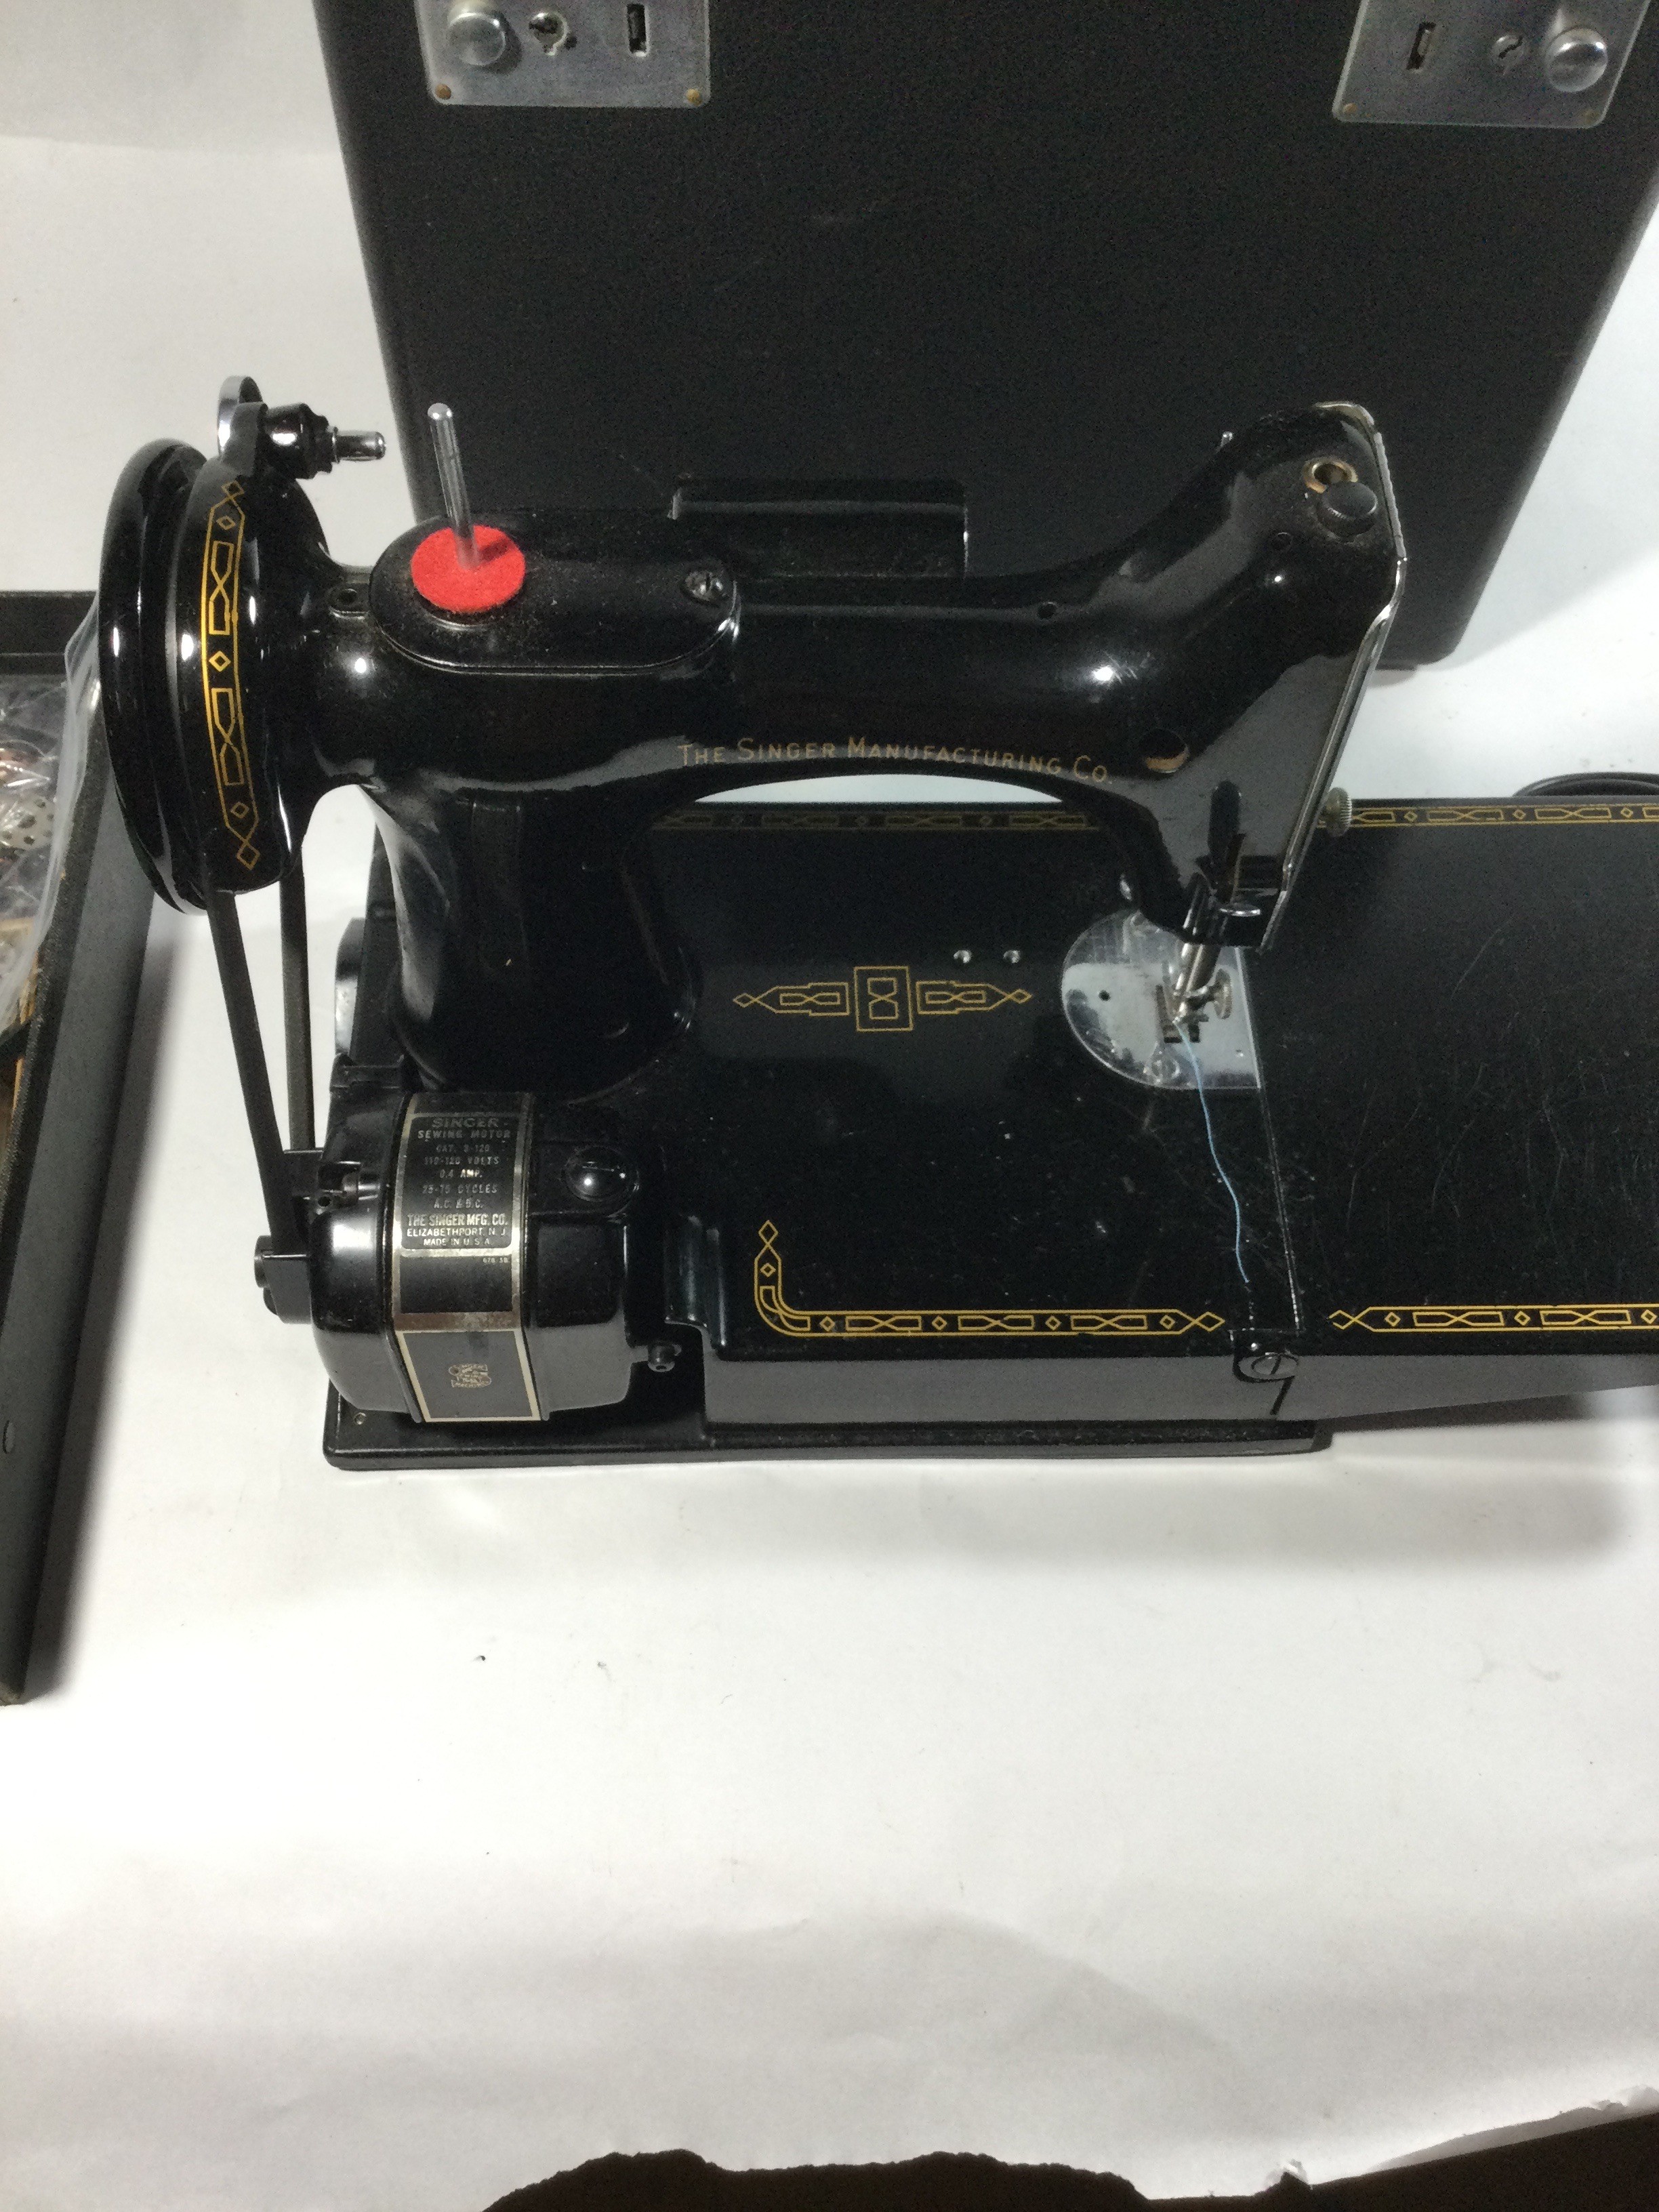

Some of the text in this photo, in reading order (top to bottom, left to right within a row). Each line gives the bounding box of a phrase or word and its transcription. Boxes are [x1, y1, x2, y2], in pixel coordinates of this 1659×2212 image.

[678, 743, 726, 766] THE
[737, 737, 836, 761] SINGER
[847, 735, 1062, 775] MANUFACTURING
[432, 1118, 499, 1128] SINGER
[417, 1130, 510, 1139] SEWING MOTOR
[467, 1156, 499, 1166] VOLTS
[459, 1168, 483, 1179] AMP.
[457, 1183, 497, 1194] CYCLES
[407, 1213, 509, 1227] THE SINGER MFG. CO.
[423, 1238, 447, 1246] MADE
[451, 1238, 459, 1246] IN
